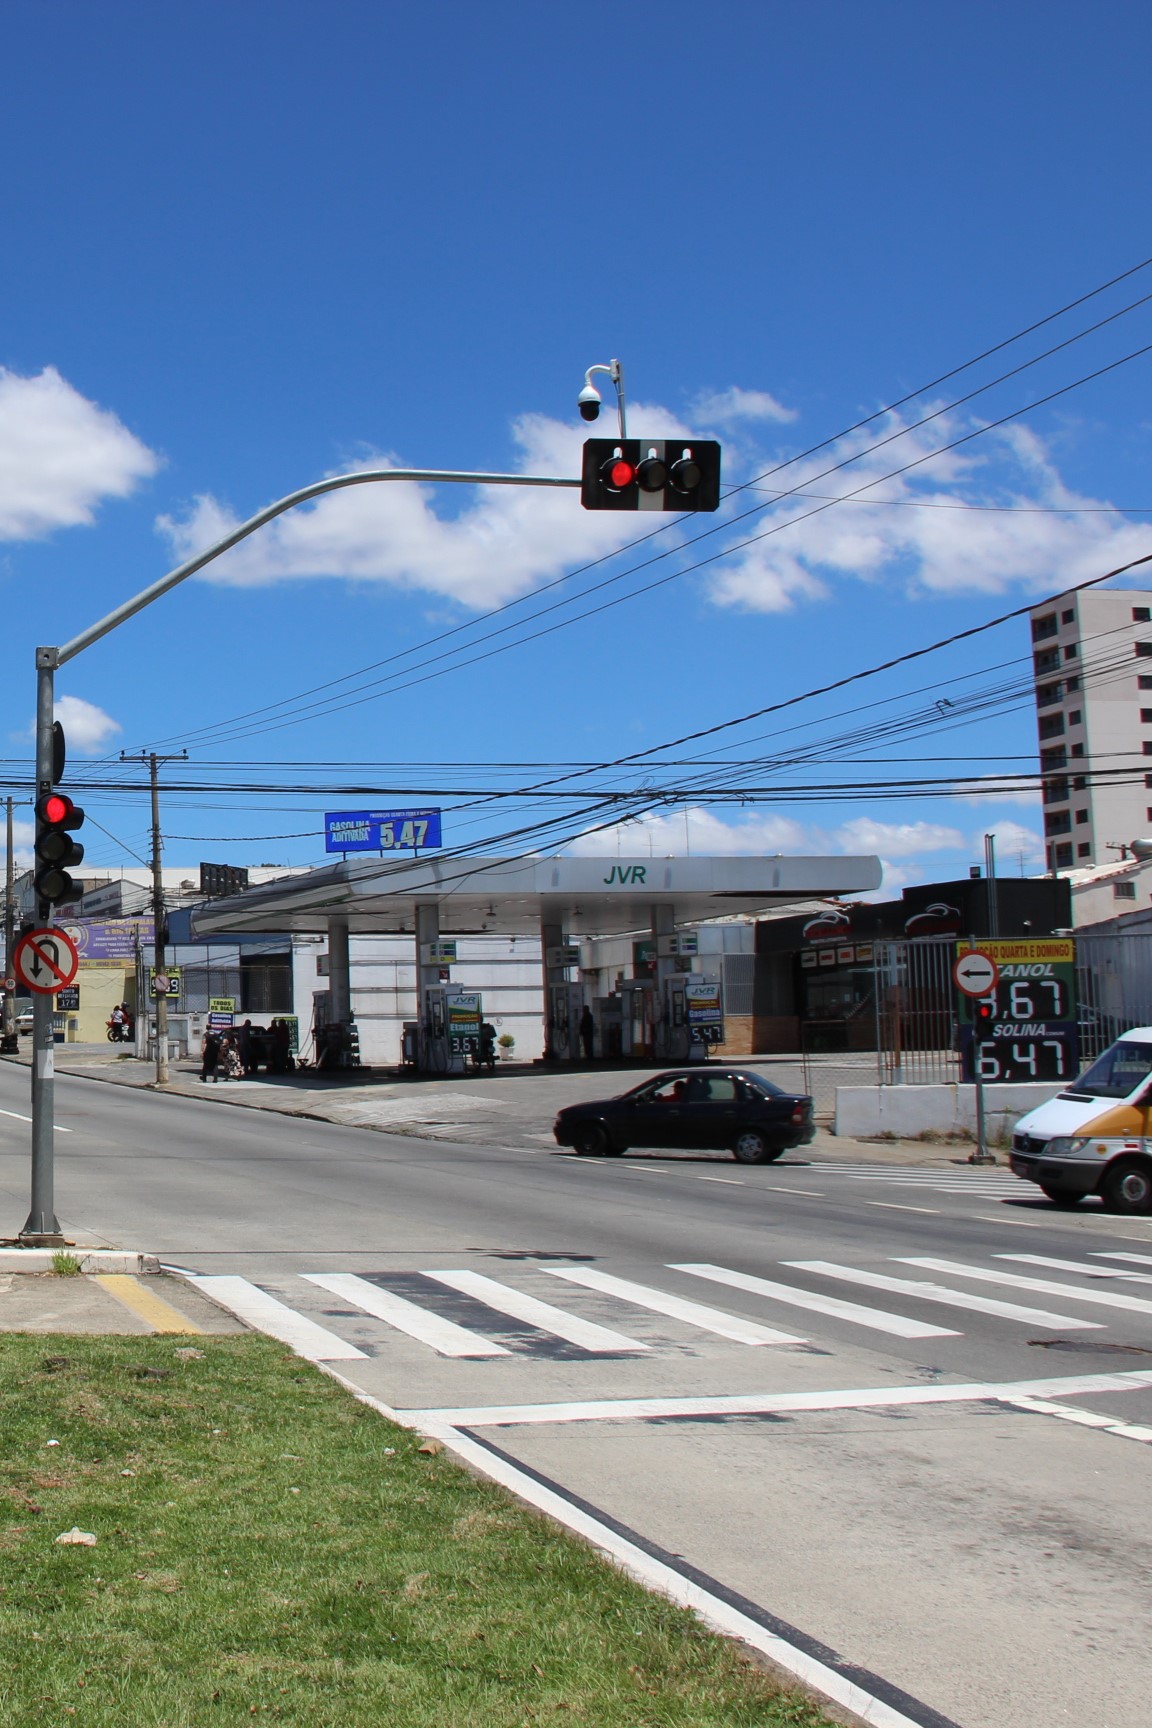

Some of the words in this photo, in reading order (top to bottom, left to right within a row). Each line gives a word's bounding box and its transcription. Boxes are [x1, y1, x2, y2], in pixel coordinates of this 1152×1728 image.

[379, 820, 428, 849] 5,47
[603, 865, 647, 885] JVR
[1000, 945, 1028, 958] QUARTA
[1030, 945, 1035, 958] E
[1036, 944, 1070, 958] DOMINGO
[997, 963, 1055, 977] ANOL
[689, 1009, 720, 1017] Gasolina
[450, 1023, 479, 1031] Etanol
[992, 1024, 1046, 1037] SOLINA
[692, 1026, 721, 1043] 5,47
[452, 1037, 479, 1053] 3,67
